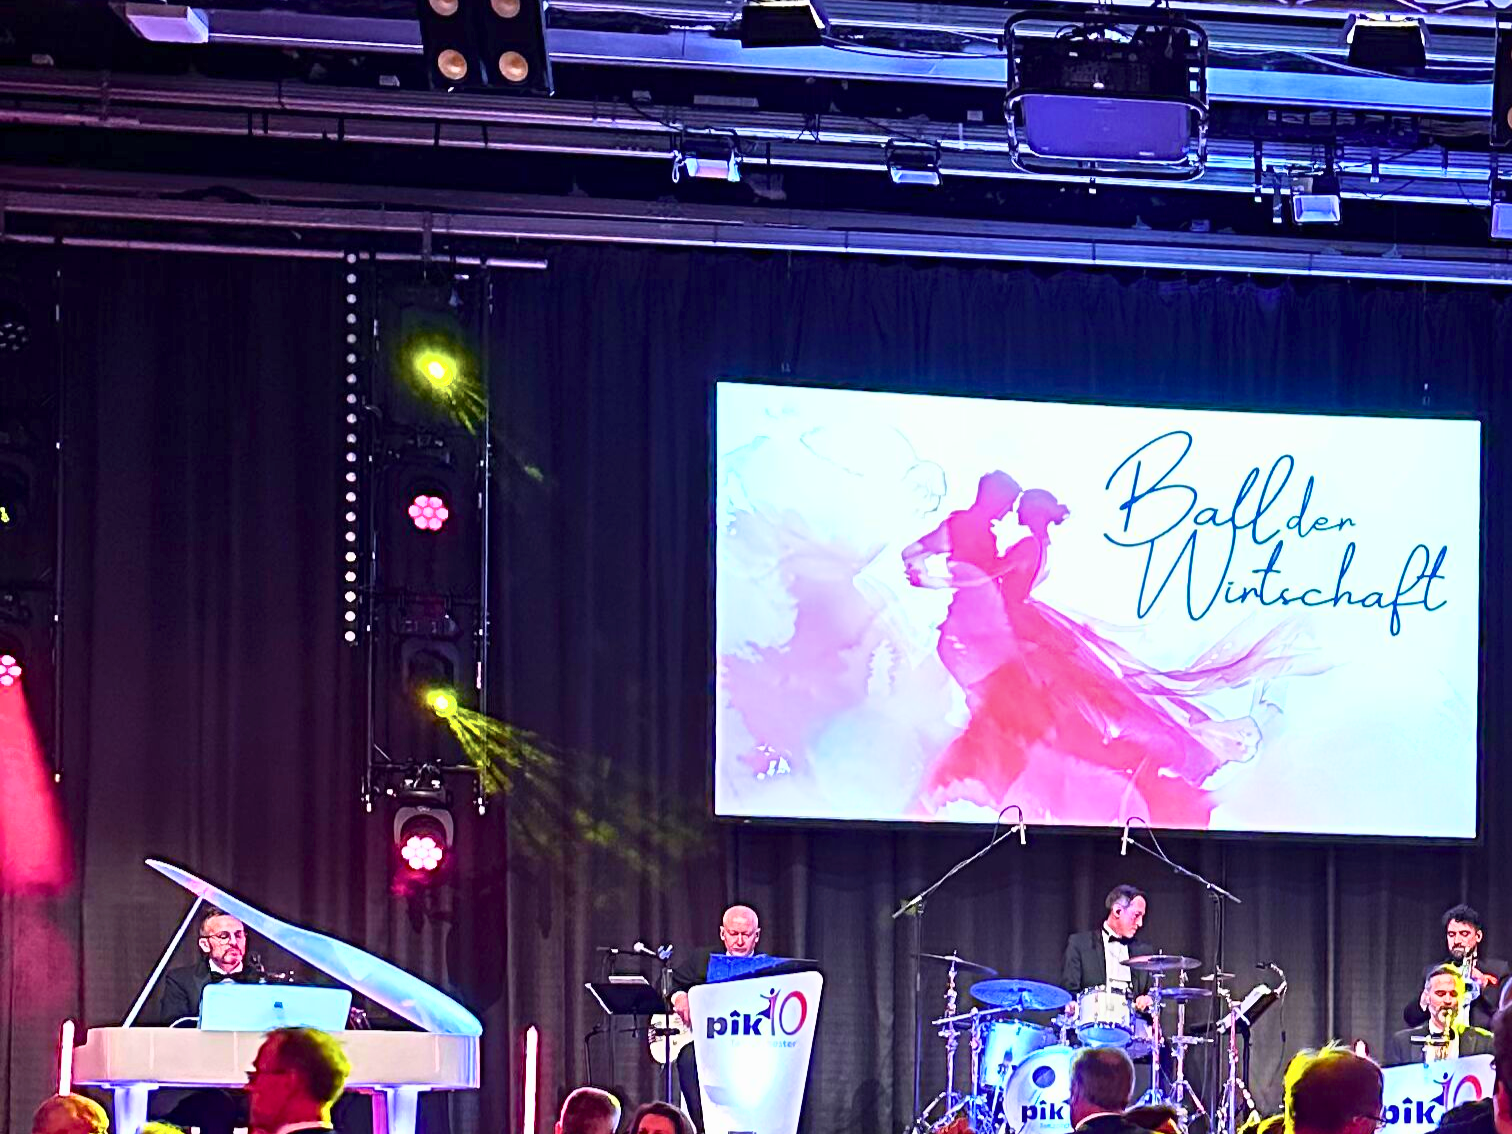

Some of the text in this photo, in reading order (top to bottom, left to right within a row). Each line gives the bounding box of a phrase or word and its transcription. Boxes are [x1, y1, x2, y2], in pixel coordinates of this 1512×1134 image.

[1104, 430, 1356, 546] Ball der
[1137, 528, 1448, 636] Wirtschaft
